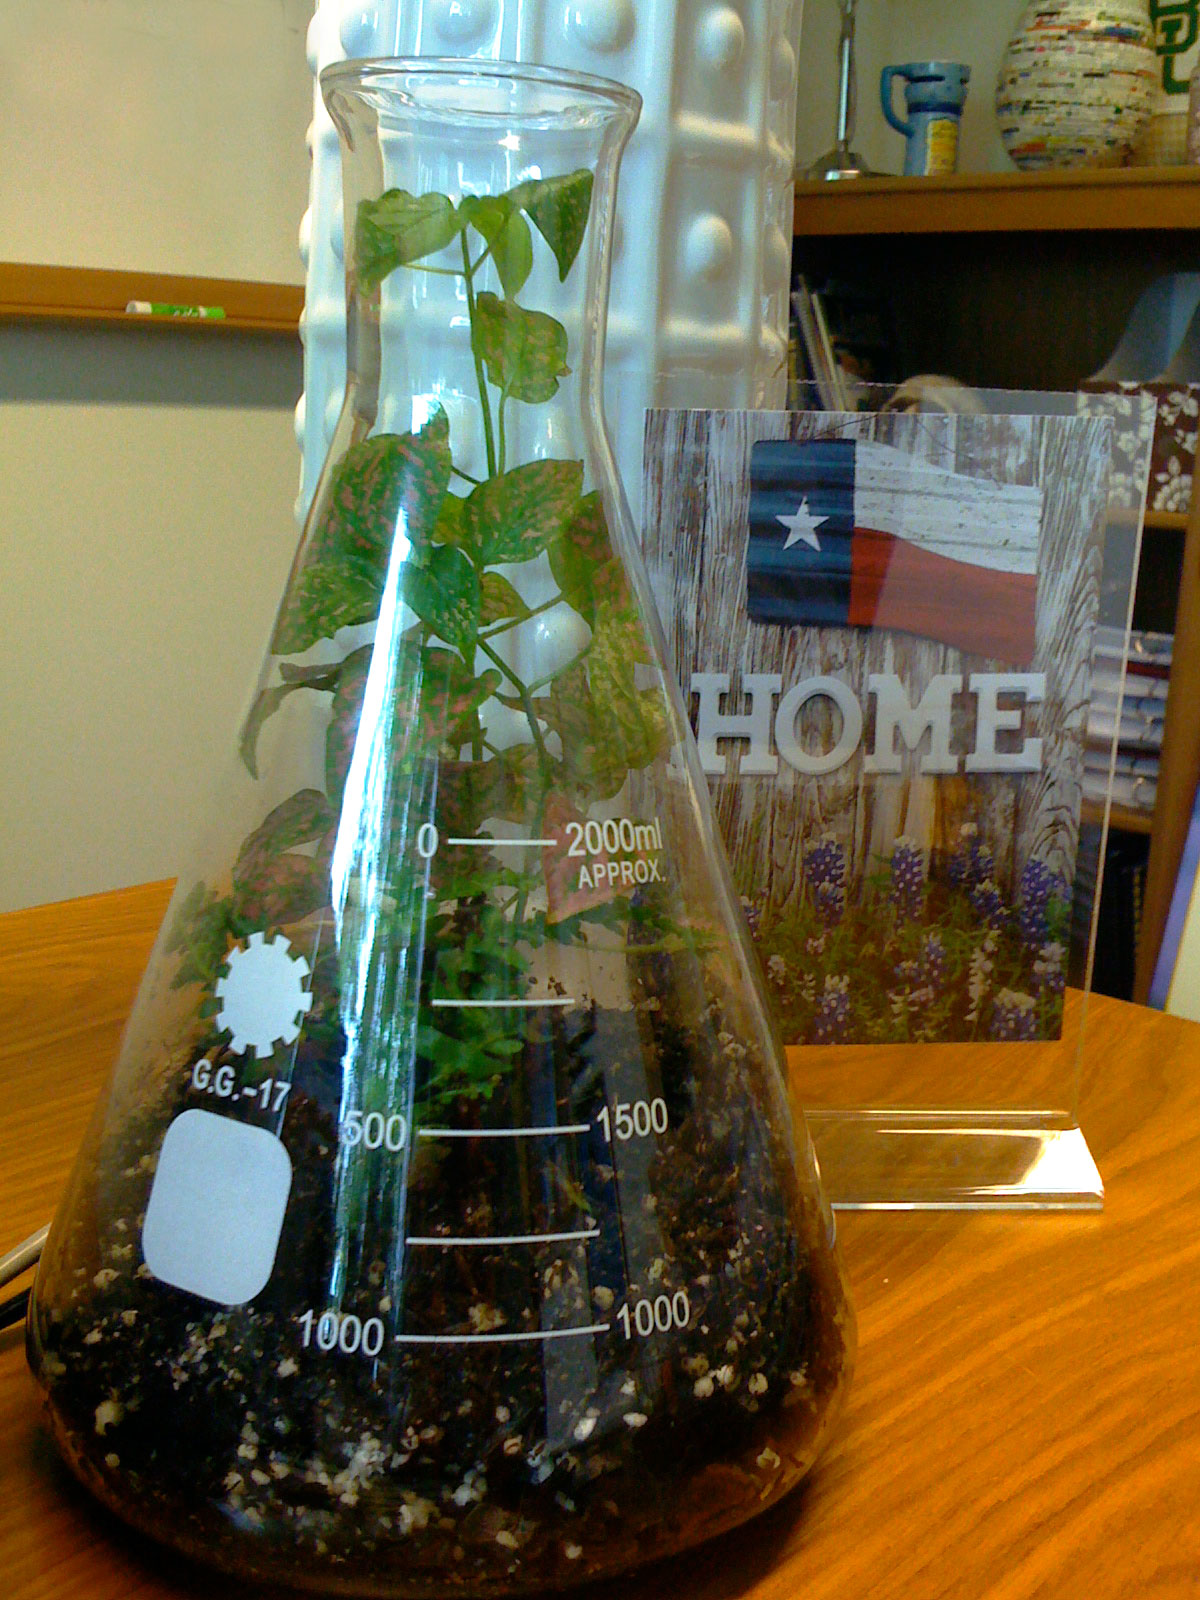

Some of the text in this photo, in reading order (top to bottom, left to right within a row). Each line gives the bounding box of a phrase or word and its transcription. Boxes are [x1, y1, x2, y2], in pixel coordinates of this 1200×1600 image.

[691, 672, 1047, 775] HOME
[417, 823, 439, 858] 0
[565, 817, 663, 857] 2000ml
[578, 859, 666, 889] APPROX.
[340, 1110, 409, 1152] 500
[596, 1098, 669, 1142] 1500
[298, 1310, 384, 1356] 1000
[616, 1291, 691, 1340] 1000
